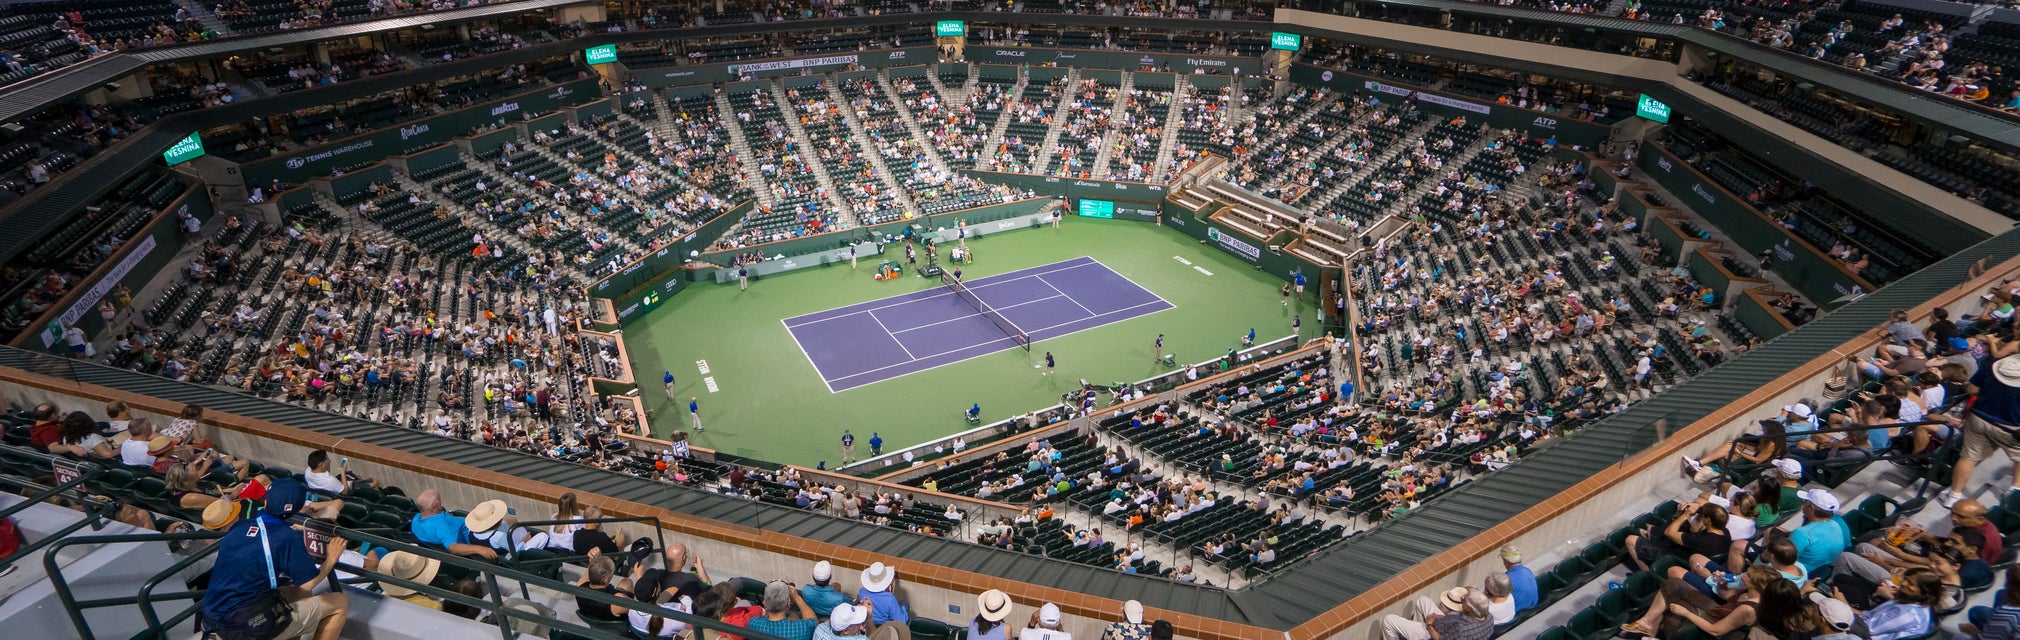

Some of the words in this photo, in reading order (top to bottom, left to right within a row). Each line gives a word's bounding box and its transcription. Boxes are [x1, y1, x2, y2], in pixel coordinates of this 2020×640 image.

[589, 52, 614, 60] VESNINA
[822, 56, 856, 64] PARIBAS
[1187, 58, 1198, 66] Fly
[1641, 105, 1667, 117] VESNINA
[1534, 116, 1556, 126] ATP
[167, 142, 200, 158] VESNINA
[305, 151, 332, 163] TENNIS
[333, 140, 374, 156] WAREHOUSE
[1219, 233, 1231, 243] BNP
[1233, 239, 1258, 256] PARIBAS
[657, 248, 669, 258] FILA
[623, 260, 645, 276] ORACLE
[61, 309, 75, 324] BNP
[75, 287, 101, 317] PARIBAS
[56, 466, 79, 478] SECTION
[307, 531, 331, 542] SECTIO
